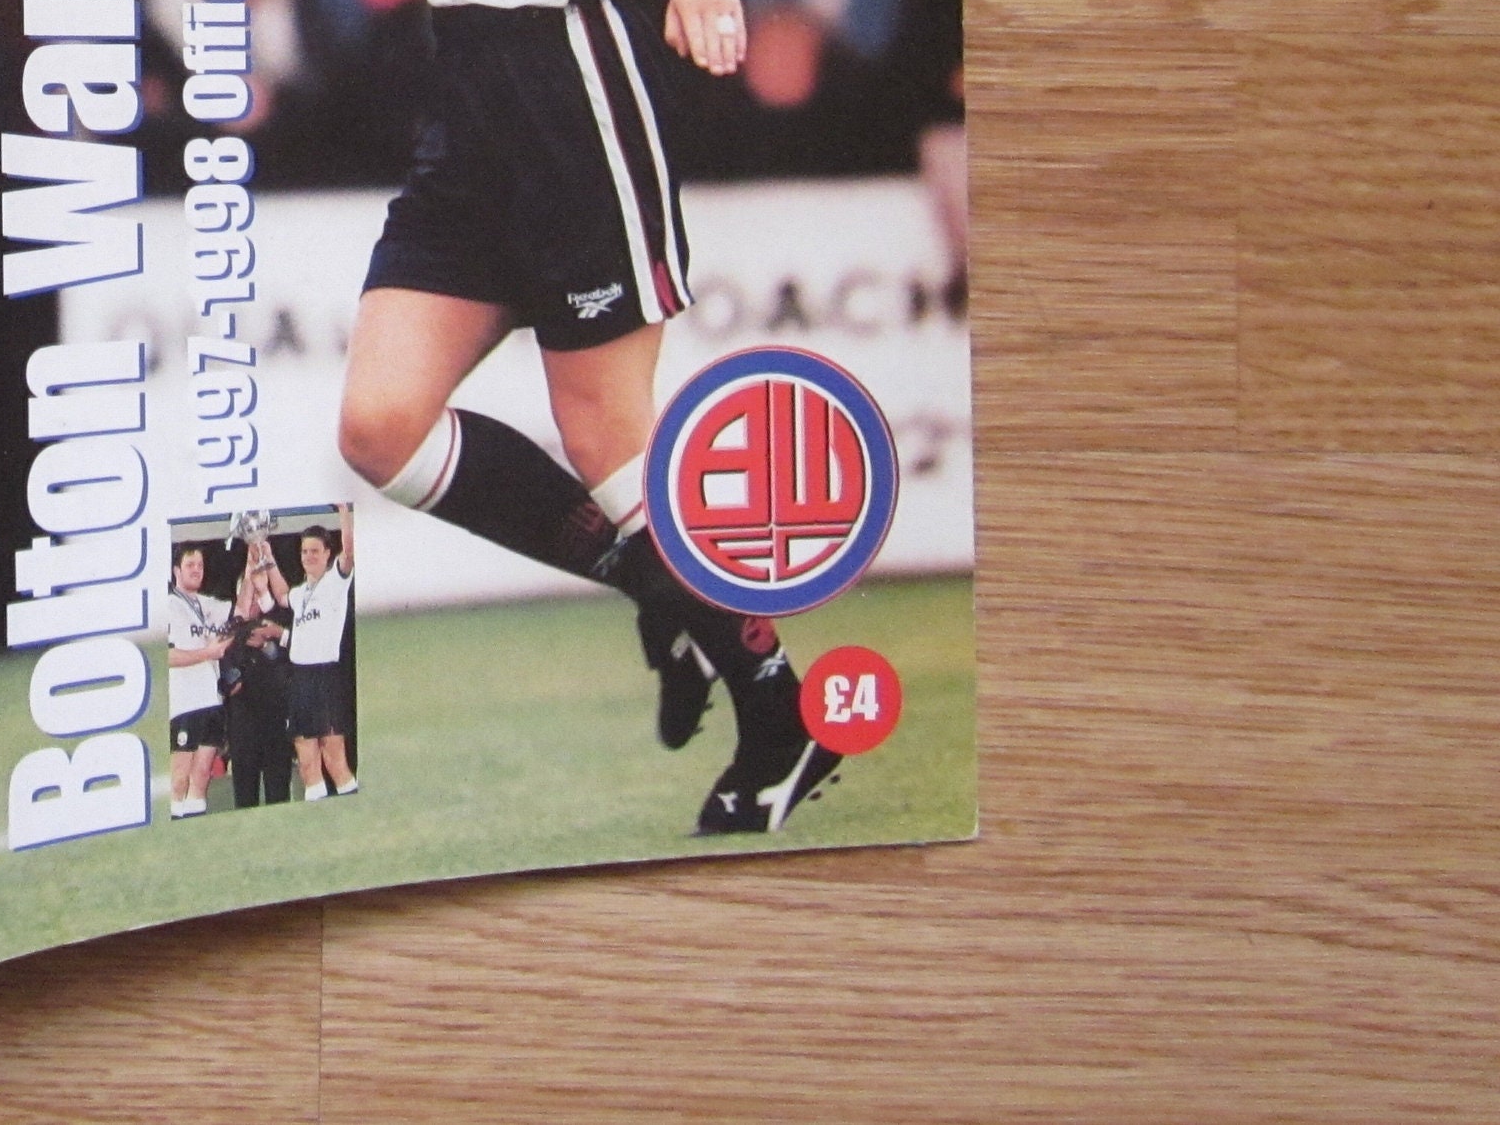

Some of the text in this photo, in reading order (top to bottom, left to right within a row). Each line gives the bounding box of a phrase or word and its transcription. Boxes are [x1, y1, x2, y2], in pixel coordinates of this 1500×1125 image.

[182, 136, 260, 506] 1997-1998
[7, 341, 153, 853] Bolton
[824, 674, 879, 723] £4
